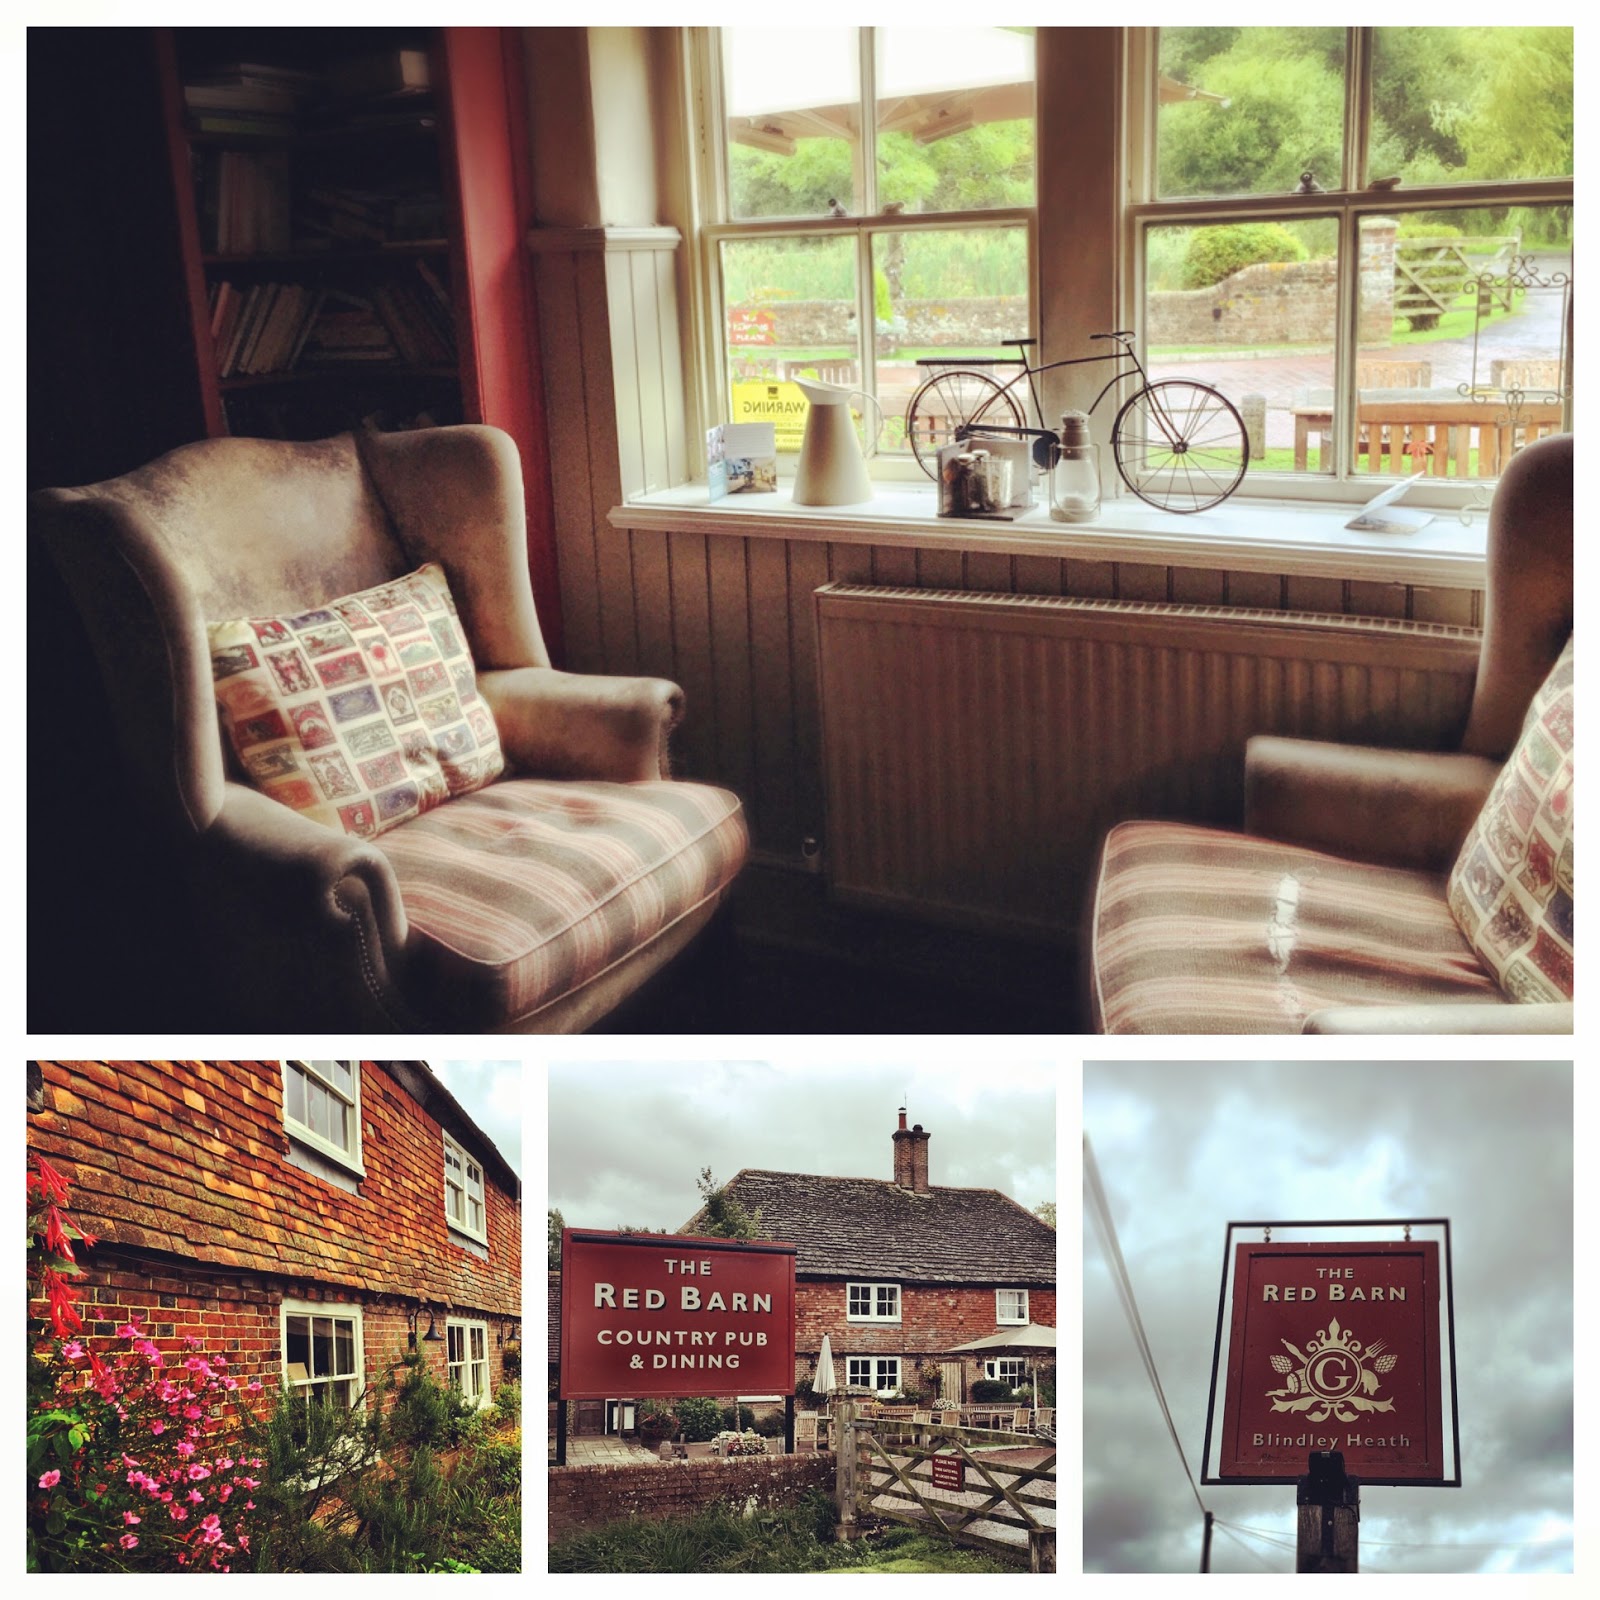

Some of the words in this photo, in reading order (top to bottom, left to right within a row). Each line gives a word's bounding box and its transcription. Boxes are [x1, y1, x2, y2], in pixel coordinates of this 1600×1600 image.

[664, 1259, 712, 1276] THE
[1316, 1268, 1355, 1280] THE
[594, 1282, 667, 1310] RED
[681, 1286, 772, 1314] BARN
[1263, 1284, 1318, 1302] RED
[1329, 1283, 1407, 1302] BARN
[597, 1329, 718, 1346] COUNTRY
[725, 1331, 768, 1347] PUB
[629, 1354, 645, 1370] &
[653, 1354, 740, 1370] DINING
[1314, 1357, 1353, 1391] G
[1252, 1433, 1339, 1450] Blindley
[1347, 1434, 1411, 1448] Heath
